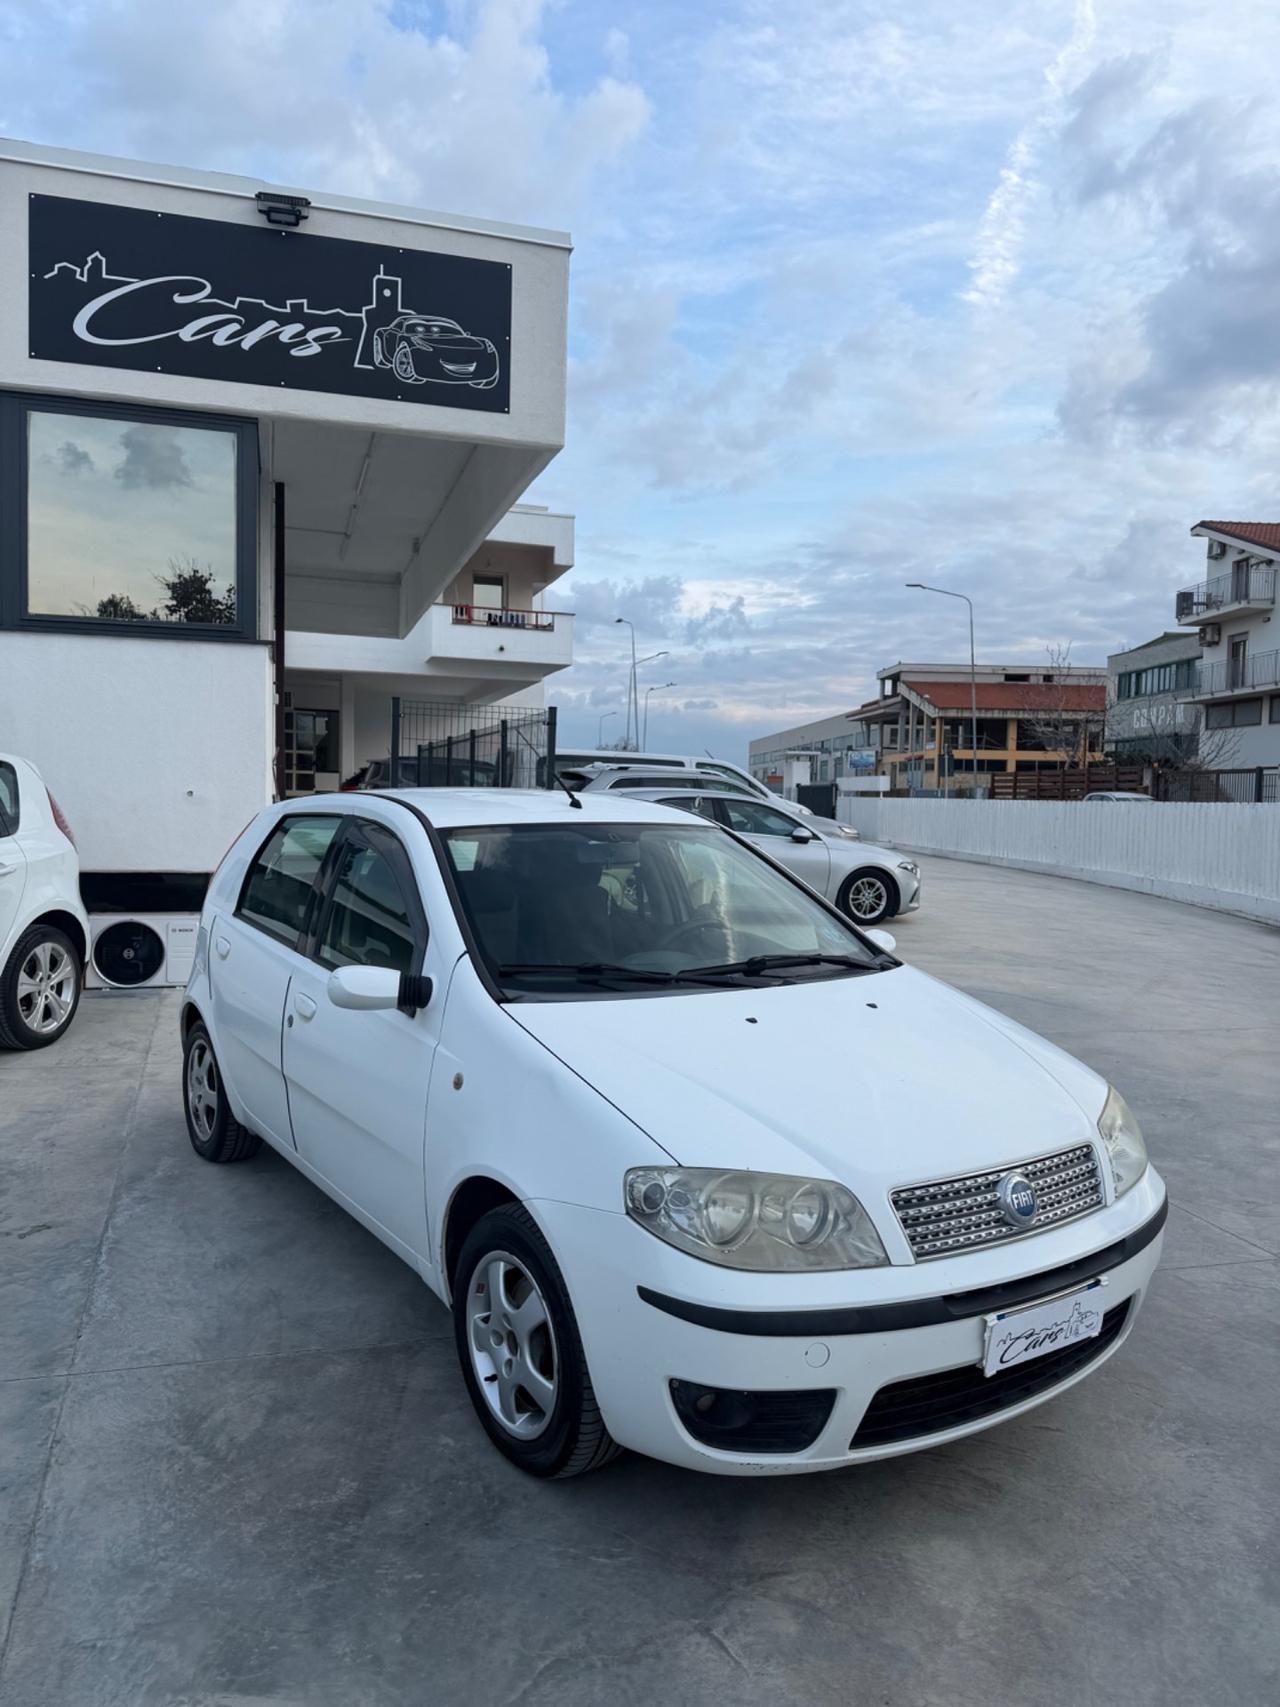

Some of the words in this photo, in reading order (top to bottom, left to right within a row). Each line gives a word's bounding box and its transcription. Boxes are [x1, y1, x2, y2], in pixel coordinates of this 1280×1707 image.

[72, 275, 352, 356] Cars
[1012, 1190, 1033, 1209] FIAT
[1000, 1328, 1064, 1364] Cars
